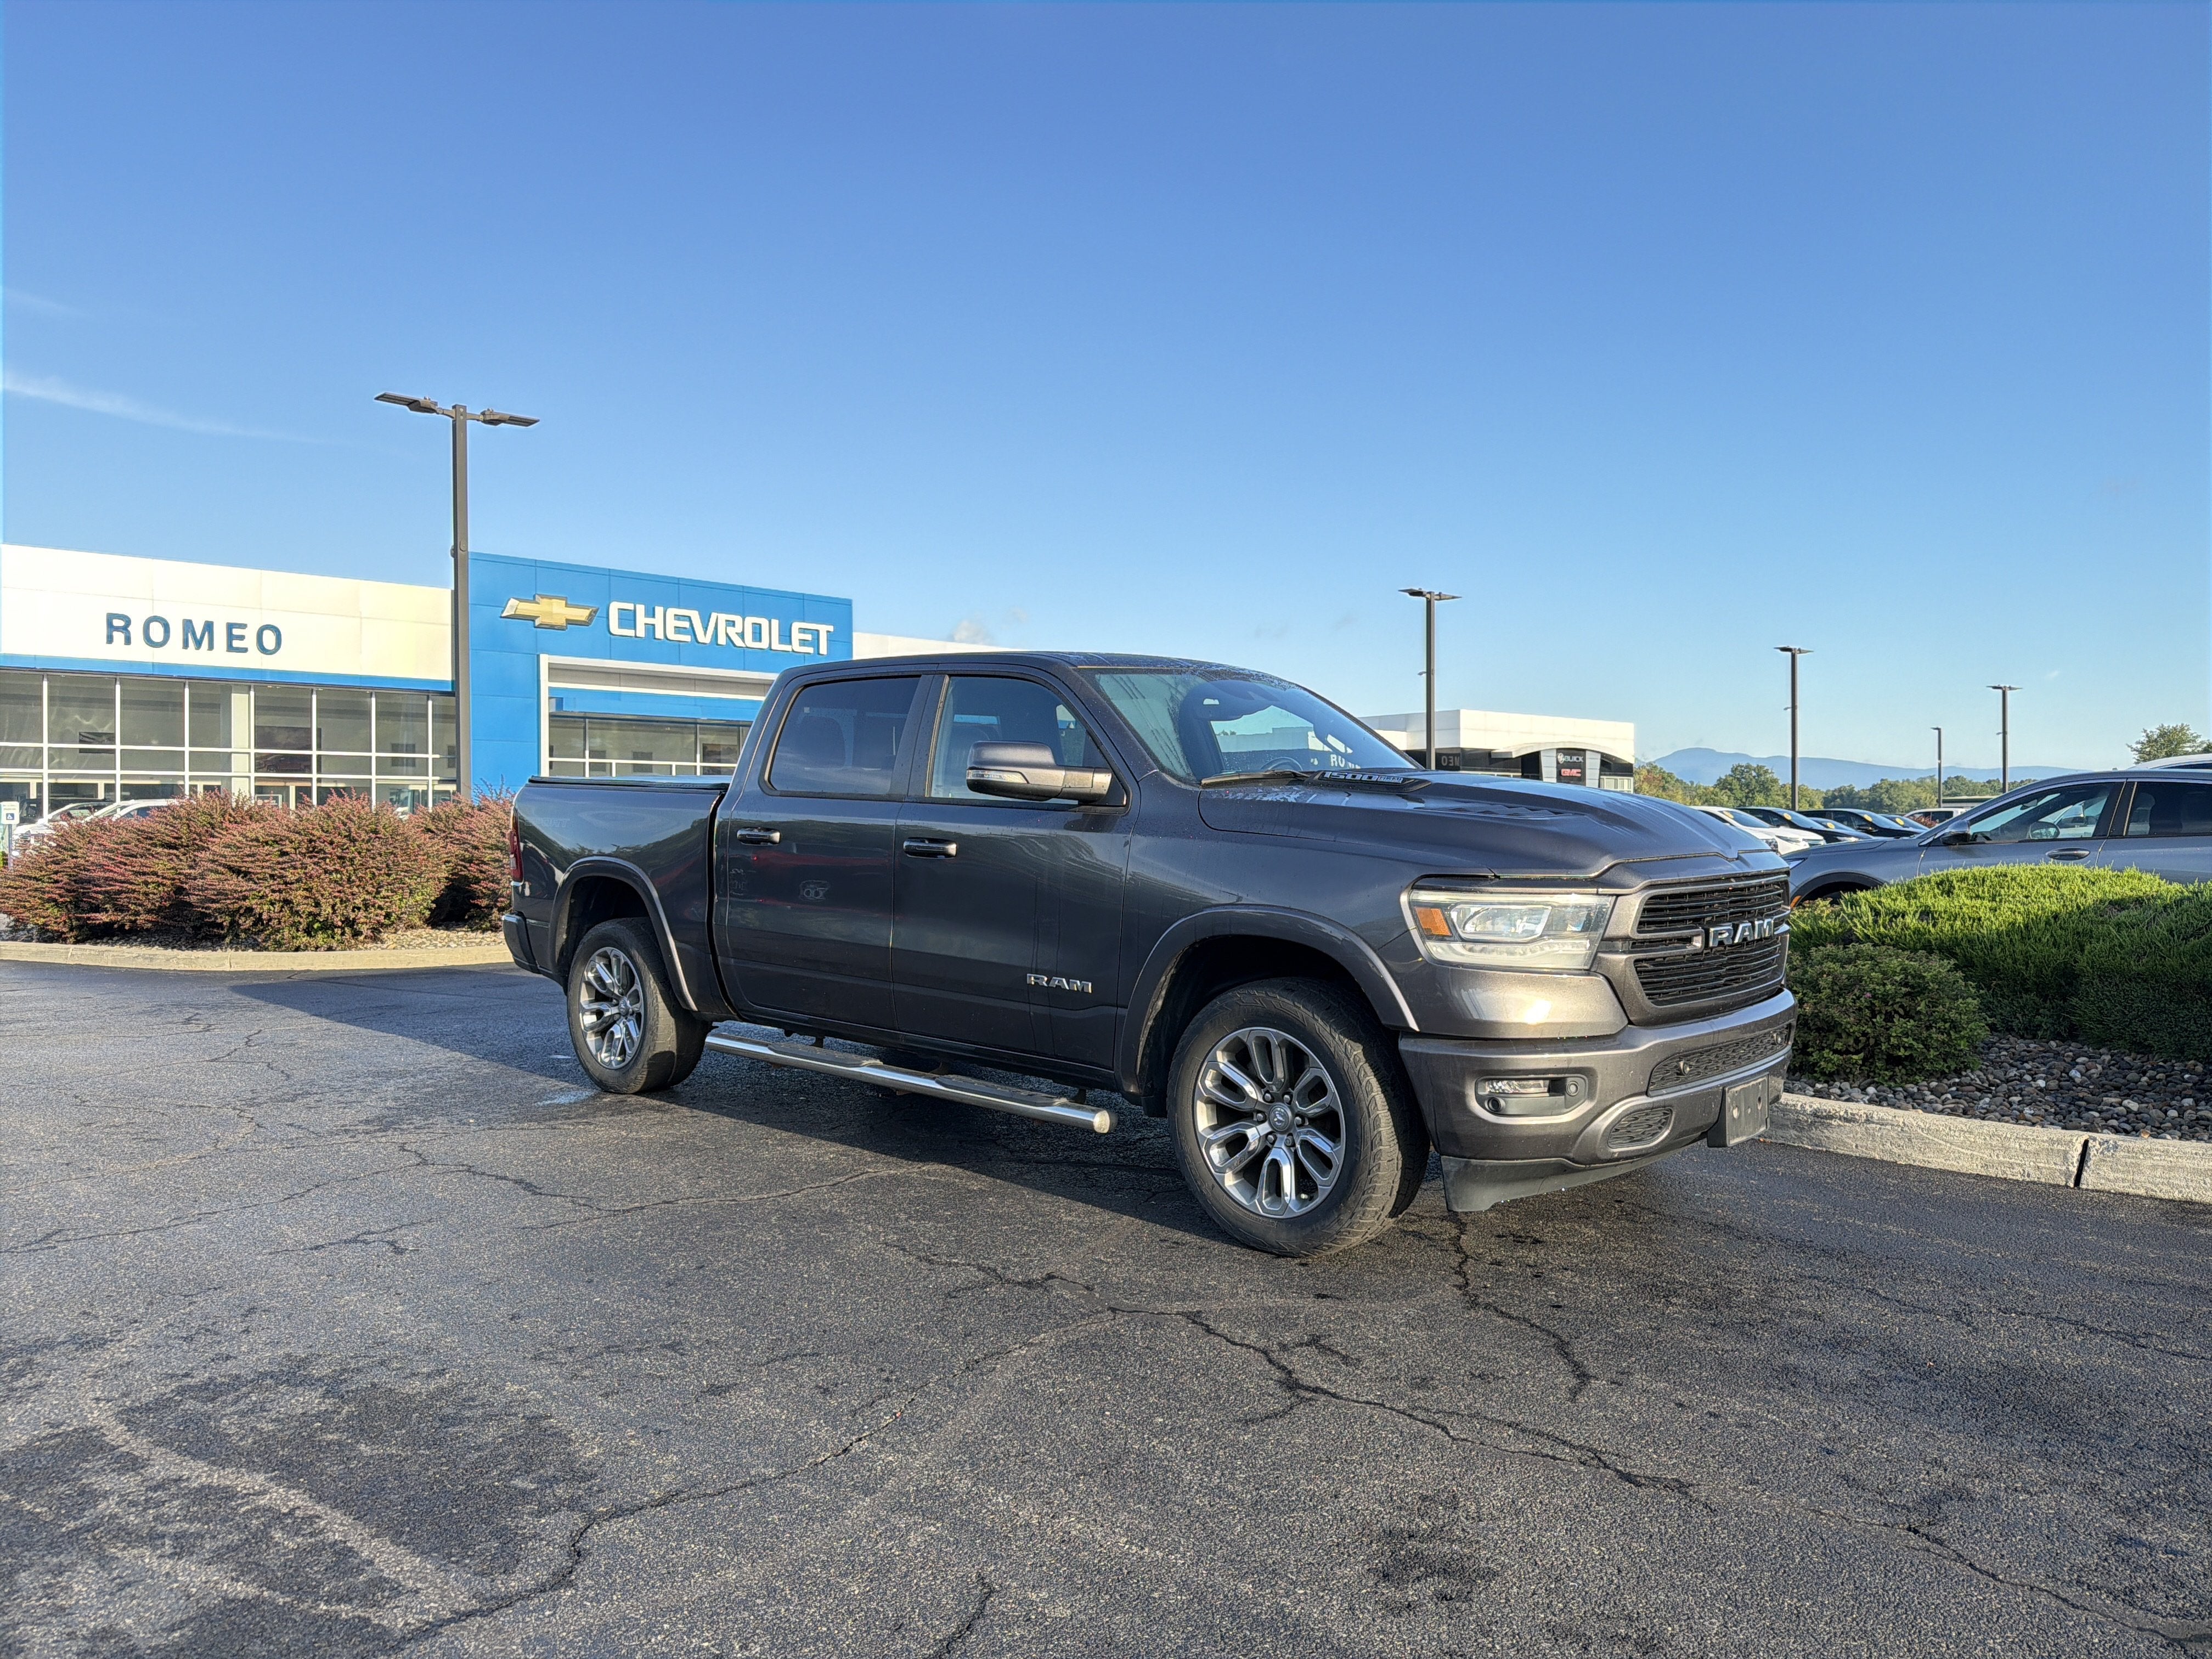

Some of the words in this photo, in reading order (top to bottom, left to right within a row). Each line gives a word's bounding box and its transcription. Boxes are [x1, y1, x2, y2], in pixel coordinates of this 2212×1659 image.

[106, 612, 282, 656] ROMEO
[609, 601, 834, 656] CHEVROLET
[1323, 771, 1379, 782] 1500
[1561, 769, 1582, 777] GMC
[1709, 918, 1774, 947] RAM
[1026, 973, 1092, 994] RAM
